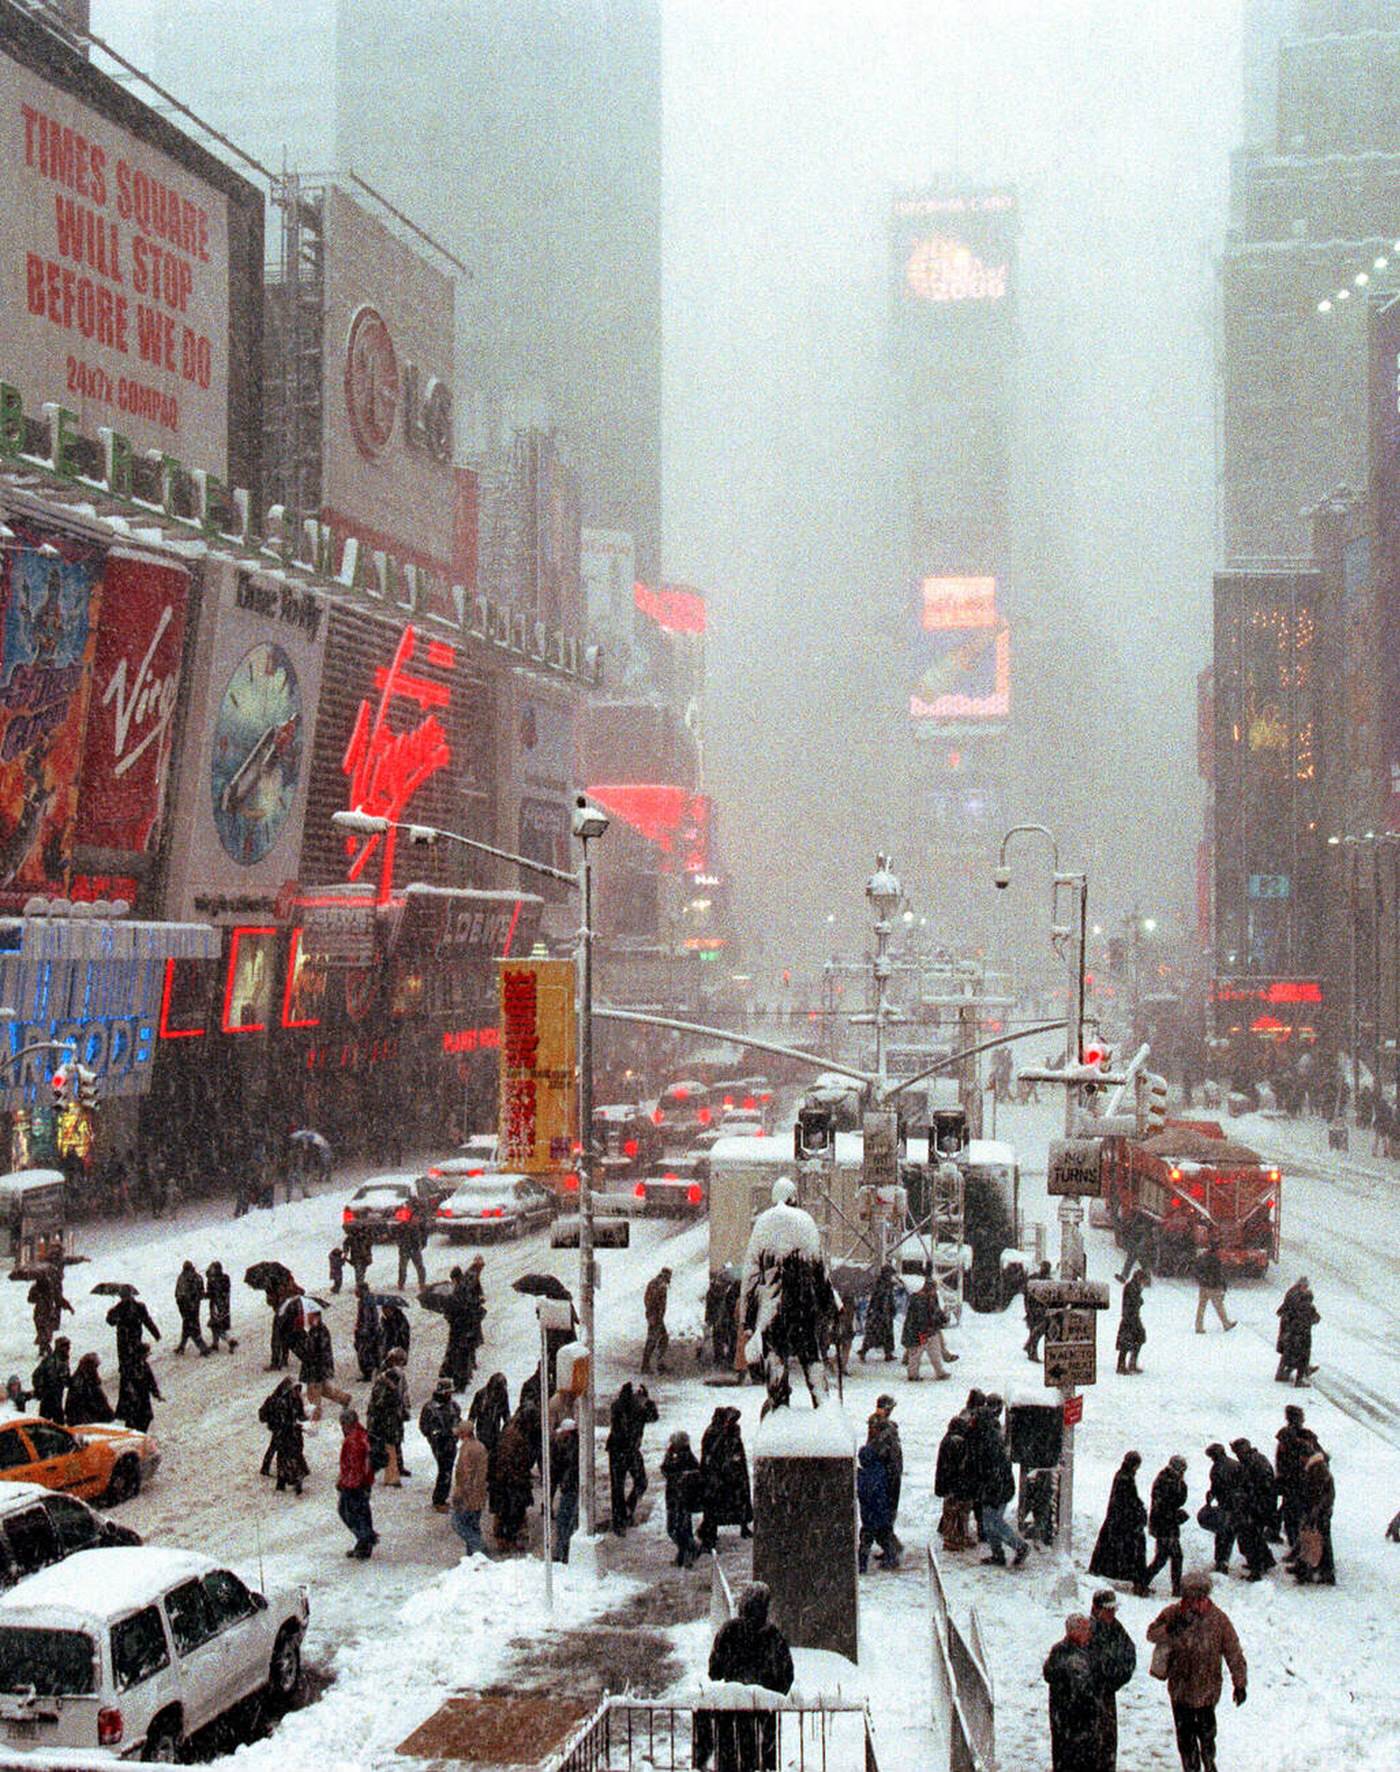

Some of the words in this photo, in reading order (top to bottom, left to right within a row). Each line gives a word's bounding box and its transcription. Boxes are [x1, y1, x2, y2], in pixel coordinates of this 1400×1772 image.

[21, 101, 107, 207] TIMES
[115, 158, 210, 263] SQUARE
[55, 191, 124, 284] WILL
[132, 234, 193, 313] STOP
[26, 250, 129, 354] BEFORE
[136, 302, 177, 373] WE
[182, 325, 211, 390] DO
[1054, 1167, 1098, 1184] TURNS
